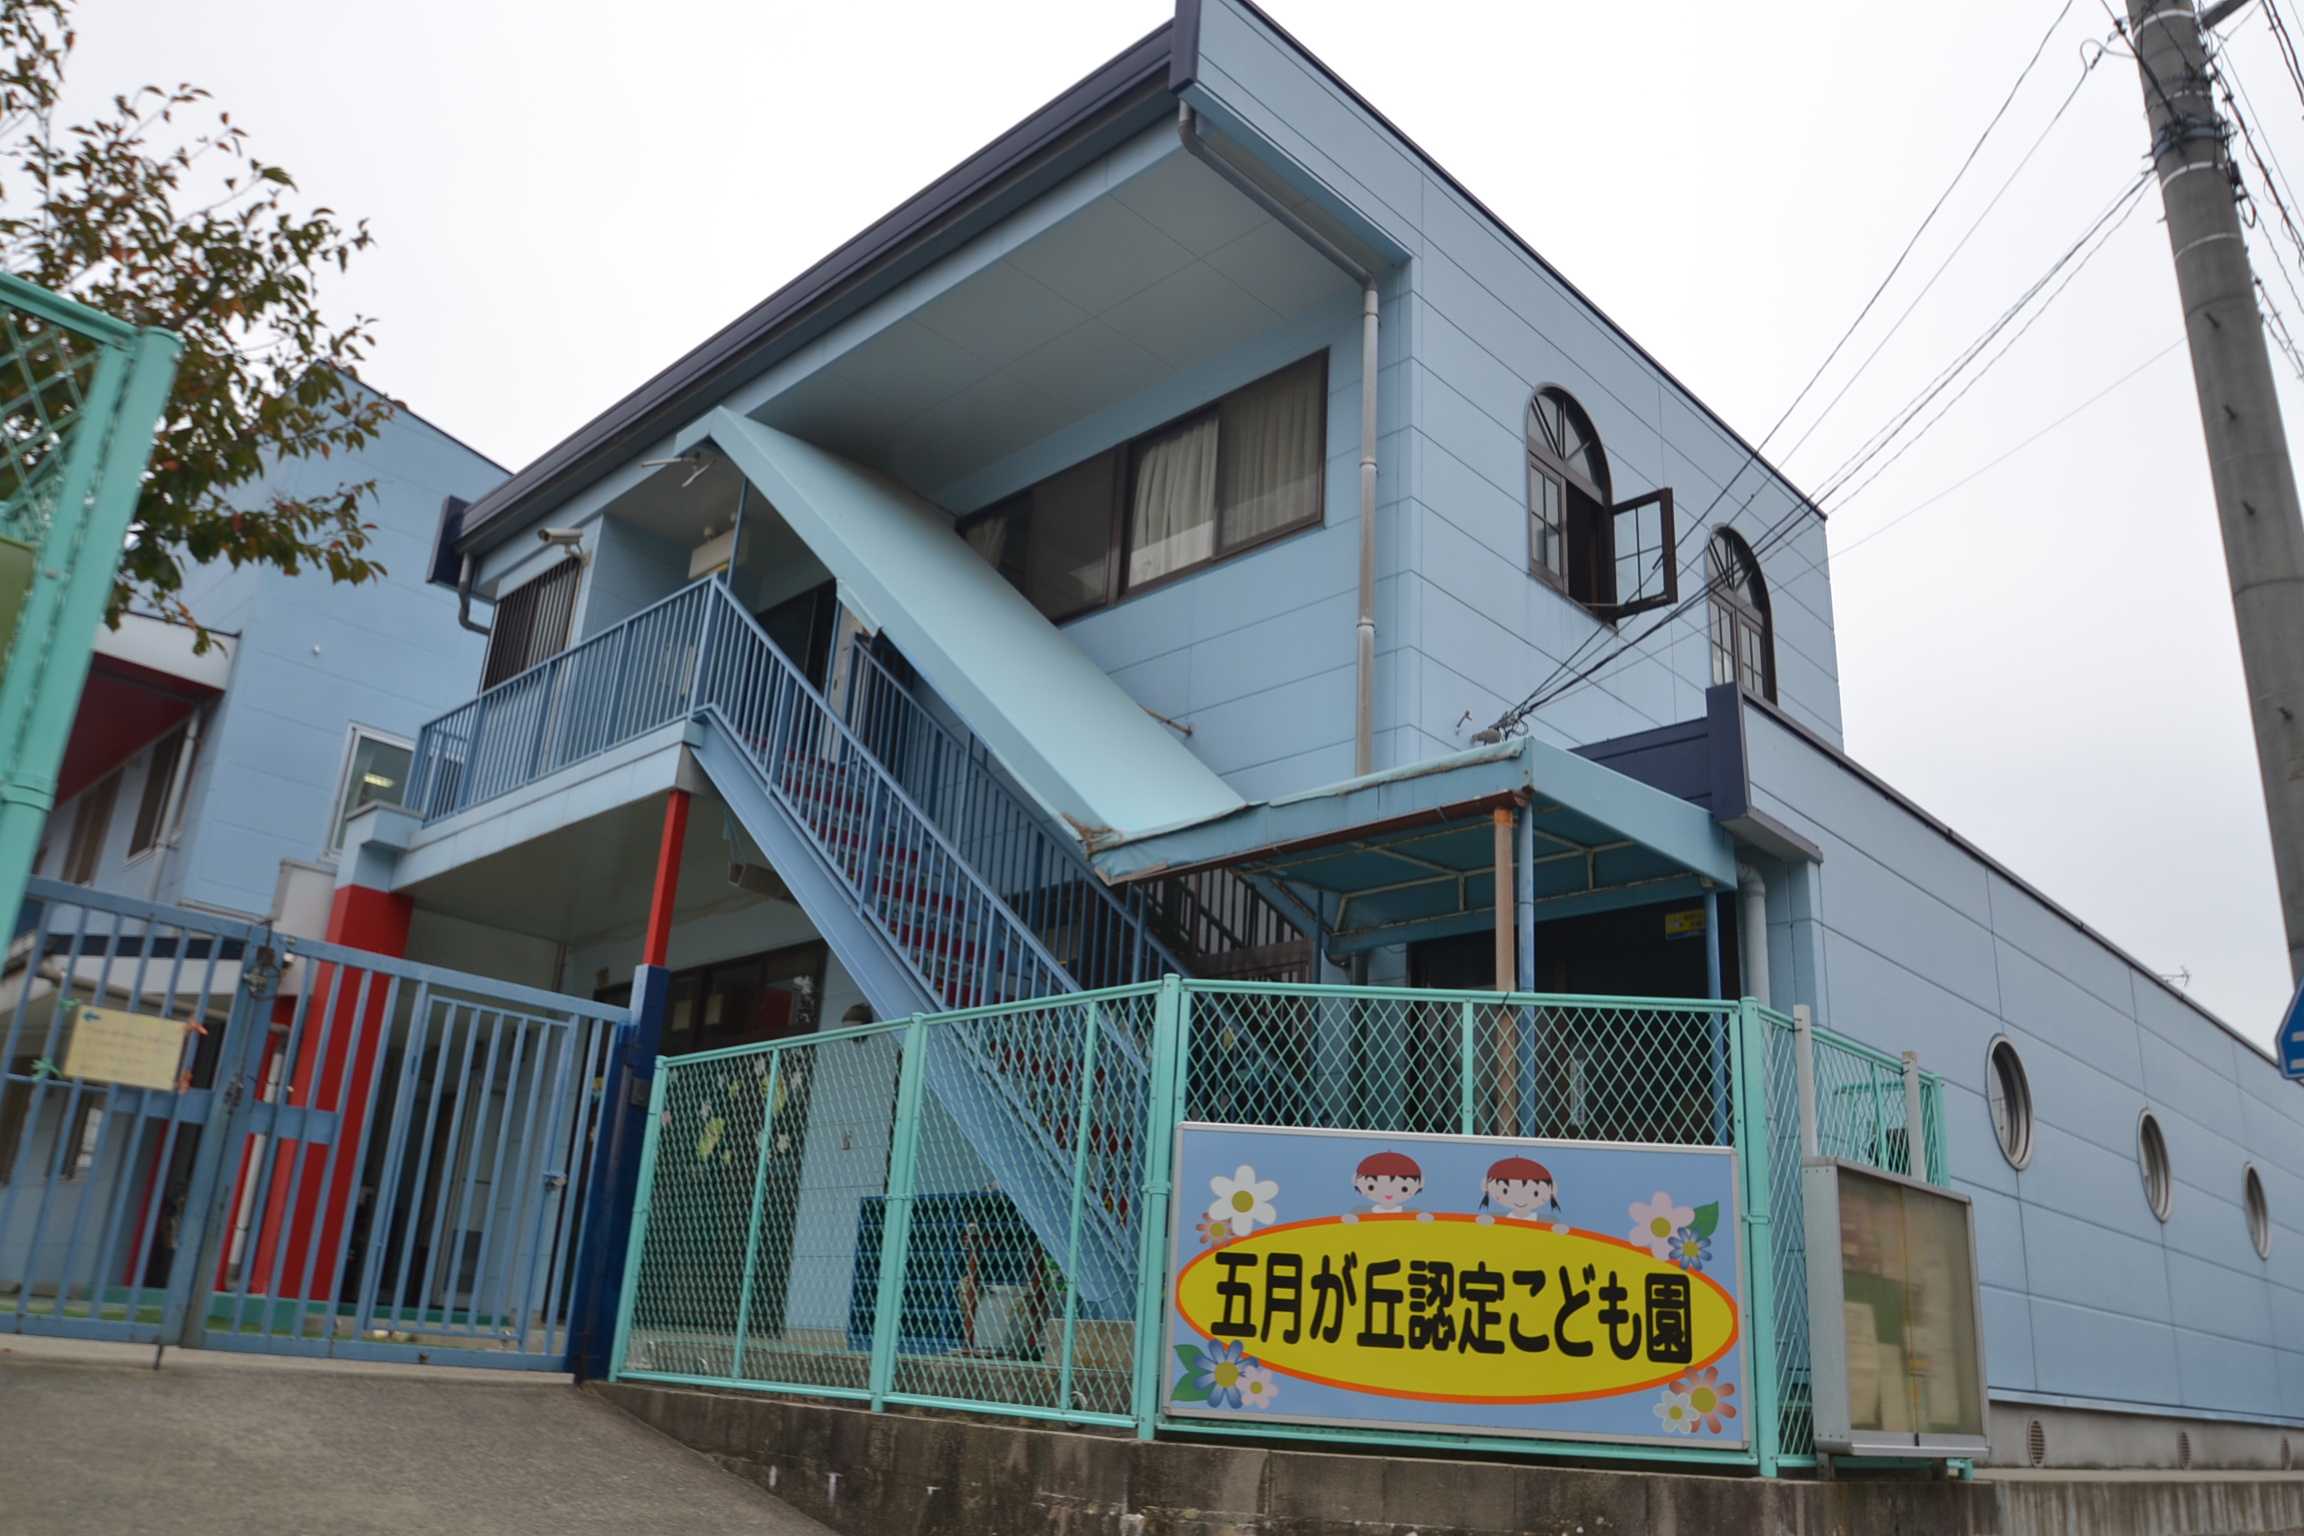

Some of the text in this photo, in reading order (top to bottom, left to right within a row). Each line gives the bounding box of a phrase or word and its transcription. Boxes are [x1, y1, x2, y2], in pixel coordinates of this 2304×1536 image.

[1210, 1251, 1694, 1364] 五月が丘認定こども園
